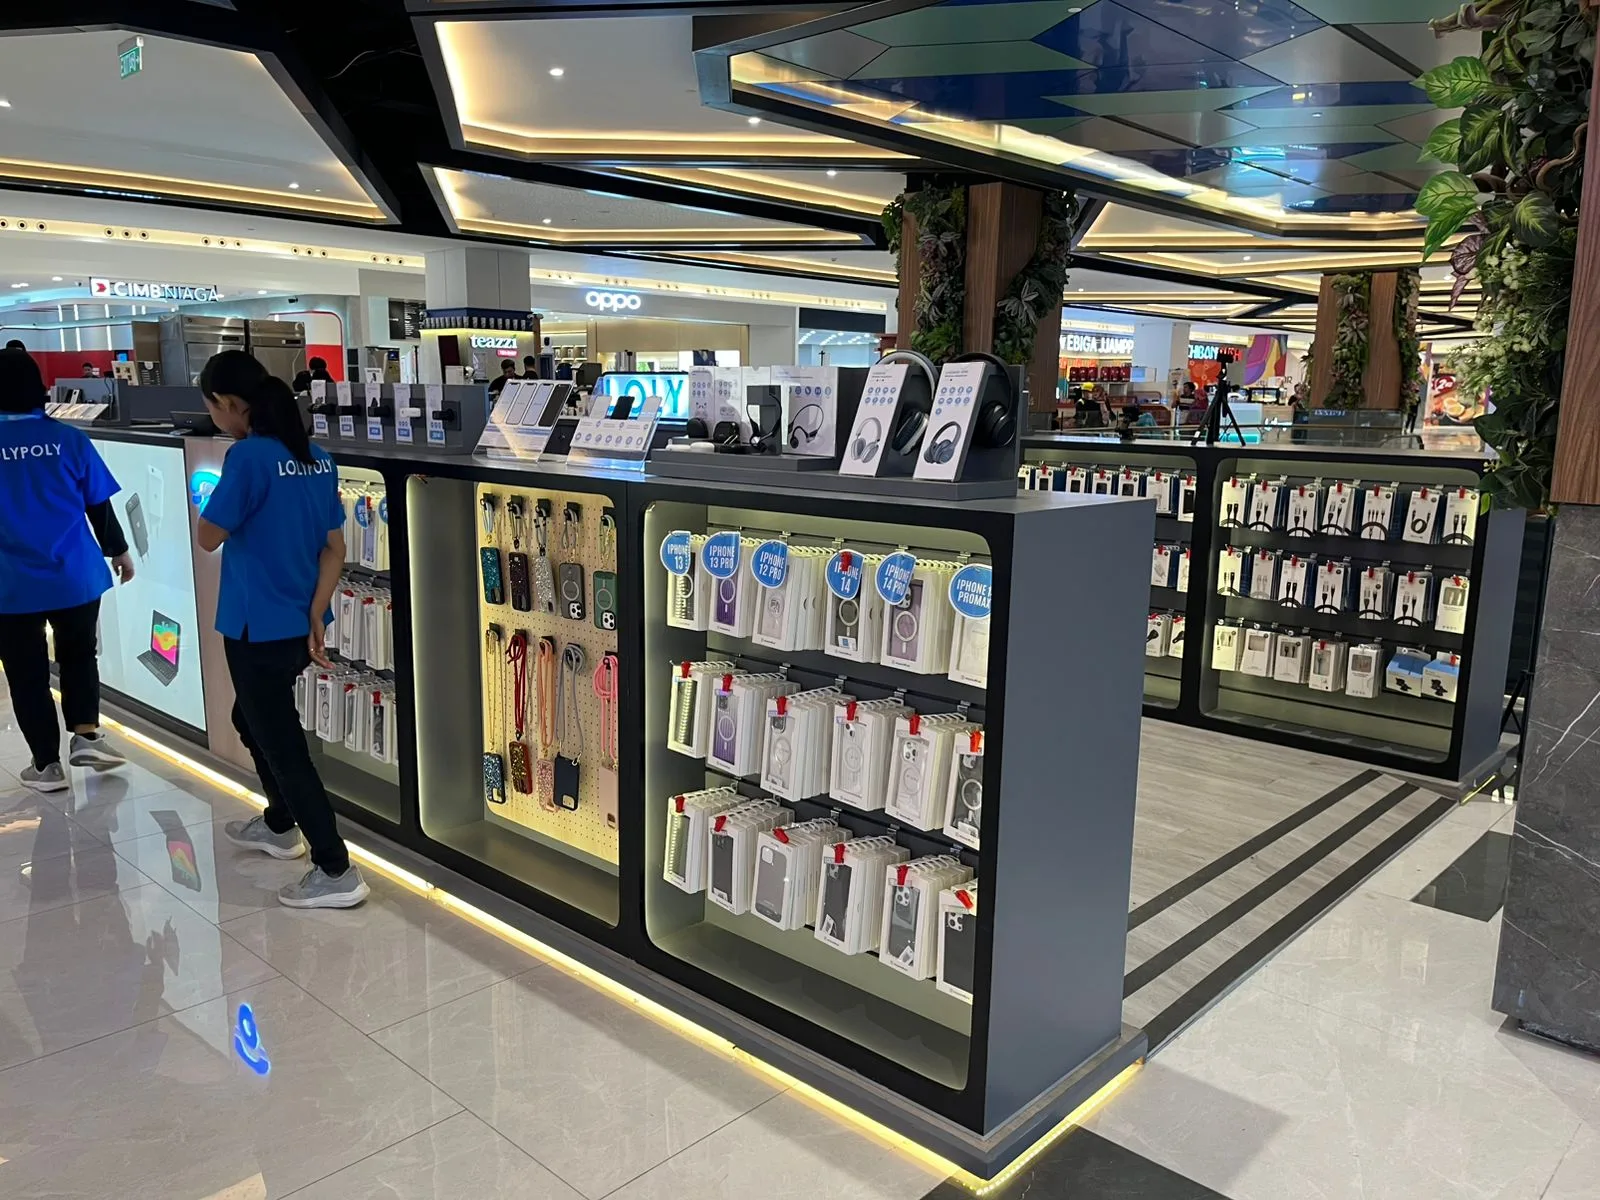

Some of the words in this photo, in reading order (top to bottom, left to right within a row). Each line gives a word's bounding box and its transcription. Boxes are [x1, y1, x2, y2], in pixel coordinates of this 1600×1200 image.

[113, 281, 160, 298] CIMB
[163, 285, 219, 301] NIAGA
[470, 334, 517, 349] teazzi
[0, 443, 61, 460] LYPOLY
[667, 543, 688, 556] IPHONE
[709, 545, 735, 557] IPHONE
[674, 556, 684, 570] 13
[710, 557, 719, 569] 13
[720, 558, 735, 569] PRO
[760, 551, 785, 570] IPHONE
[759, 563, 767, 576] 12
[768, 566, 782, 580] PRO
[834, 561, 860, 580] IPONE
[885, 563, 911, 584] IPHONE
[841, 576, 852, 593] 14
[883, 577, 893, 591] 14
[893, 580, 907, 596] PRO
[956, 578, 987, 595] IPHONE
[957, 590, 992, 609] PROMAX
